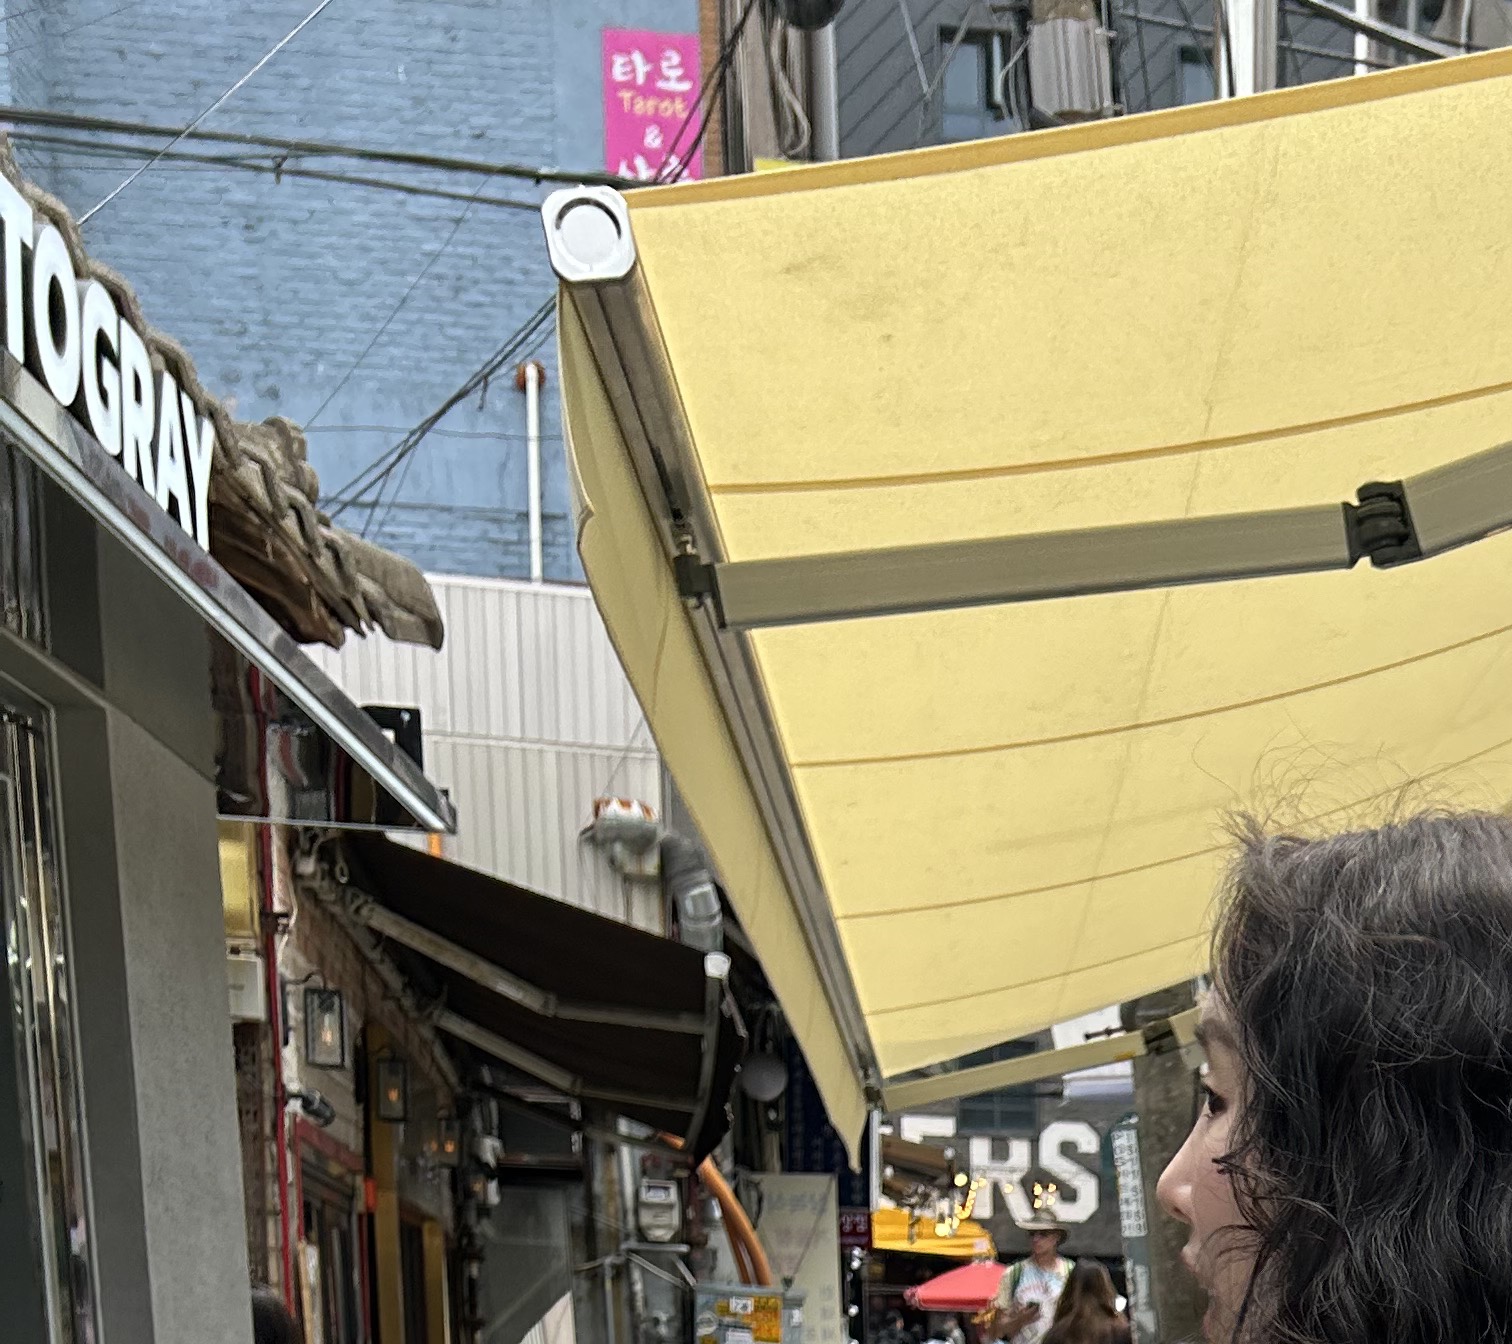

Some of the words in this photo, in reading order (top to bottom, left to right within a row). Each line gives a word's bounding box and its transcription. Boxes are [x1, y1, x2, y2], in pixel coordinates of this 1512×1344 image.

[611, 49, 694, 92] 타로
[616, 89, 688, 119] Tarot
[643, 124, 664, 149] &
[0, 172, 214, 552] TOGRAY
